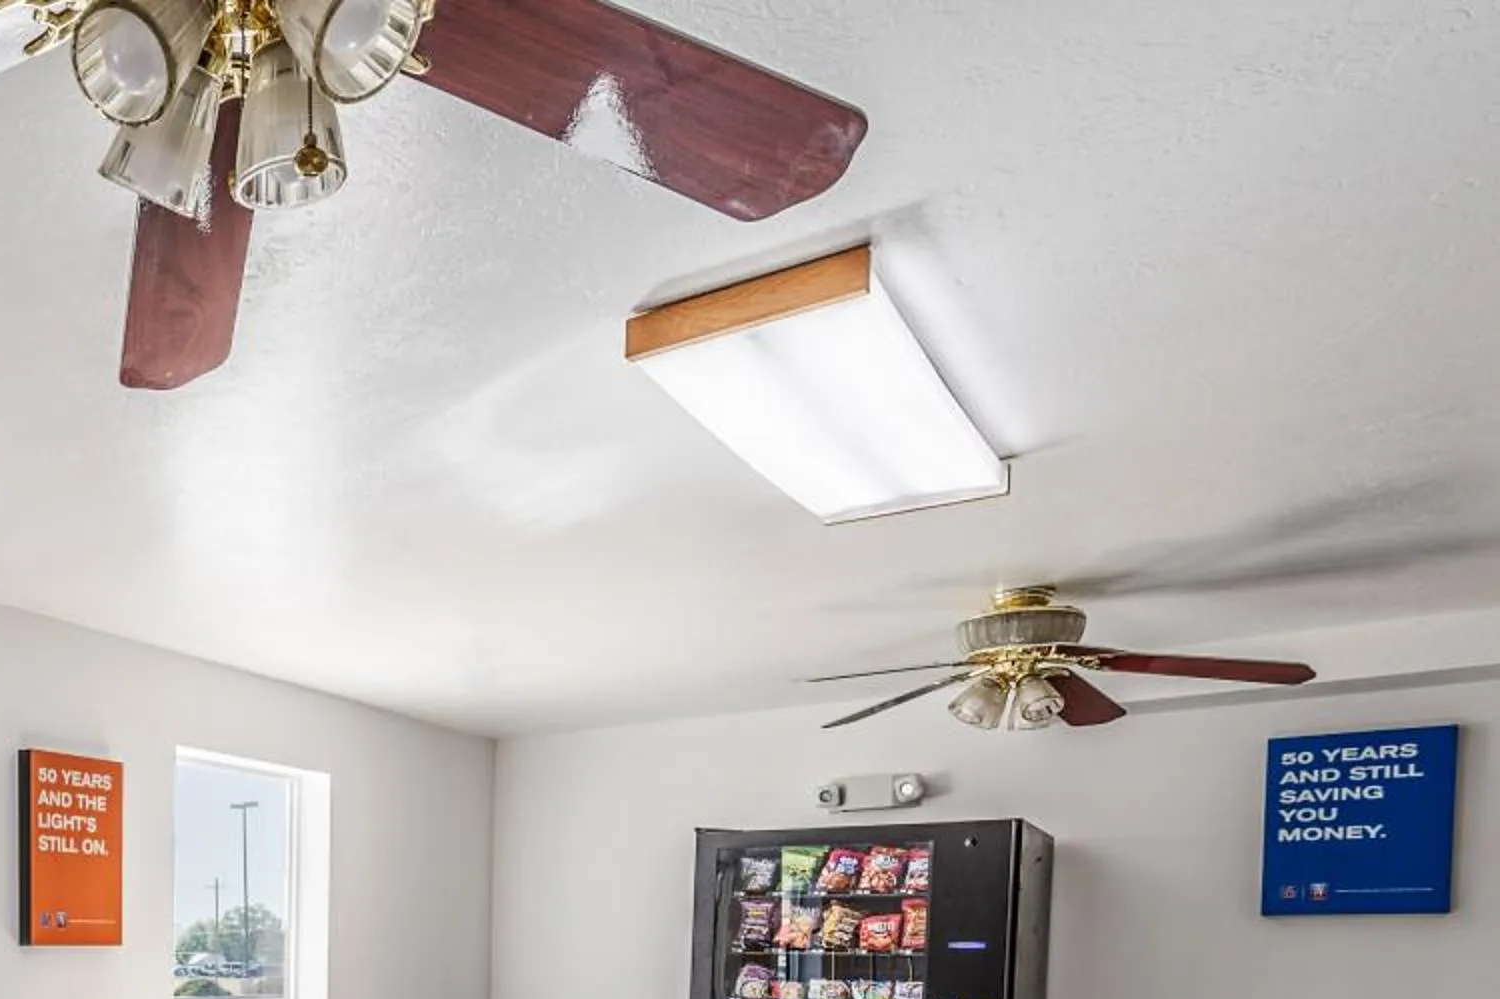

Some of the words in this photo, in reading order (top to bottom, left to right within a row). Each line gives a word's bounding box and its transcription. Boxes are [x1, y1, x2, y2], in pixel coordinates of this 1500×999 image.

[1280, 751, 1314, 765] 50
[1322, 743, 1418, 763] YEARS
[37, 767, 58, 783] 50
[61, 769, 112, 791] YEARS
[1279, 768, 1341, 785] AND
[1349, 763, 1424, 781] STILL
[37, 789, 73, 807] AND
[76, 794, 108, 812] THE
[1278, 785, 1384, 804] SAVING
[37, 812, 97, 833] LIGHT'S
[1278, 807, 1339, 823] YOU
[1277, 824, 1387, 842] MONEY.
[38, 834, 79, 854] STILL
[81, 839, 109, 856] ON.
